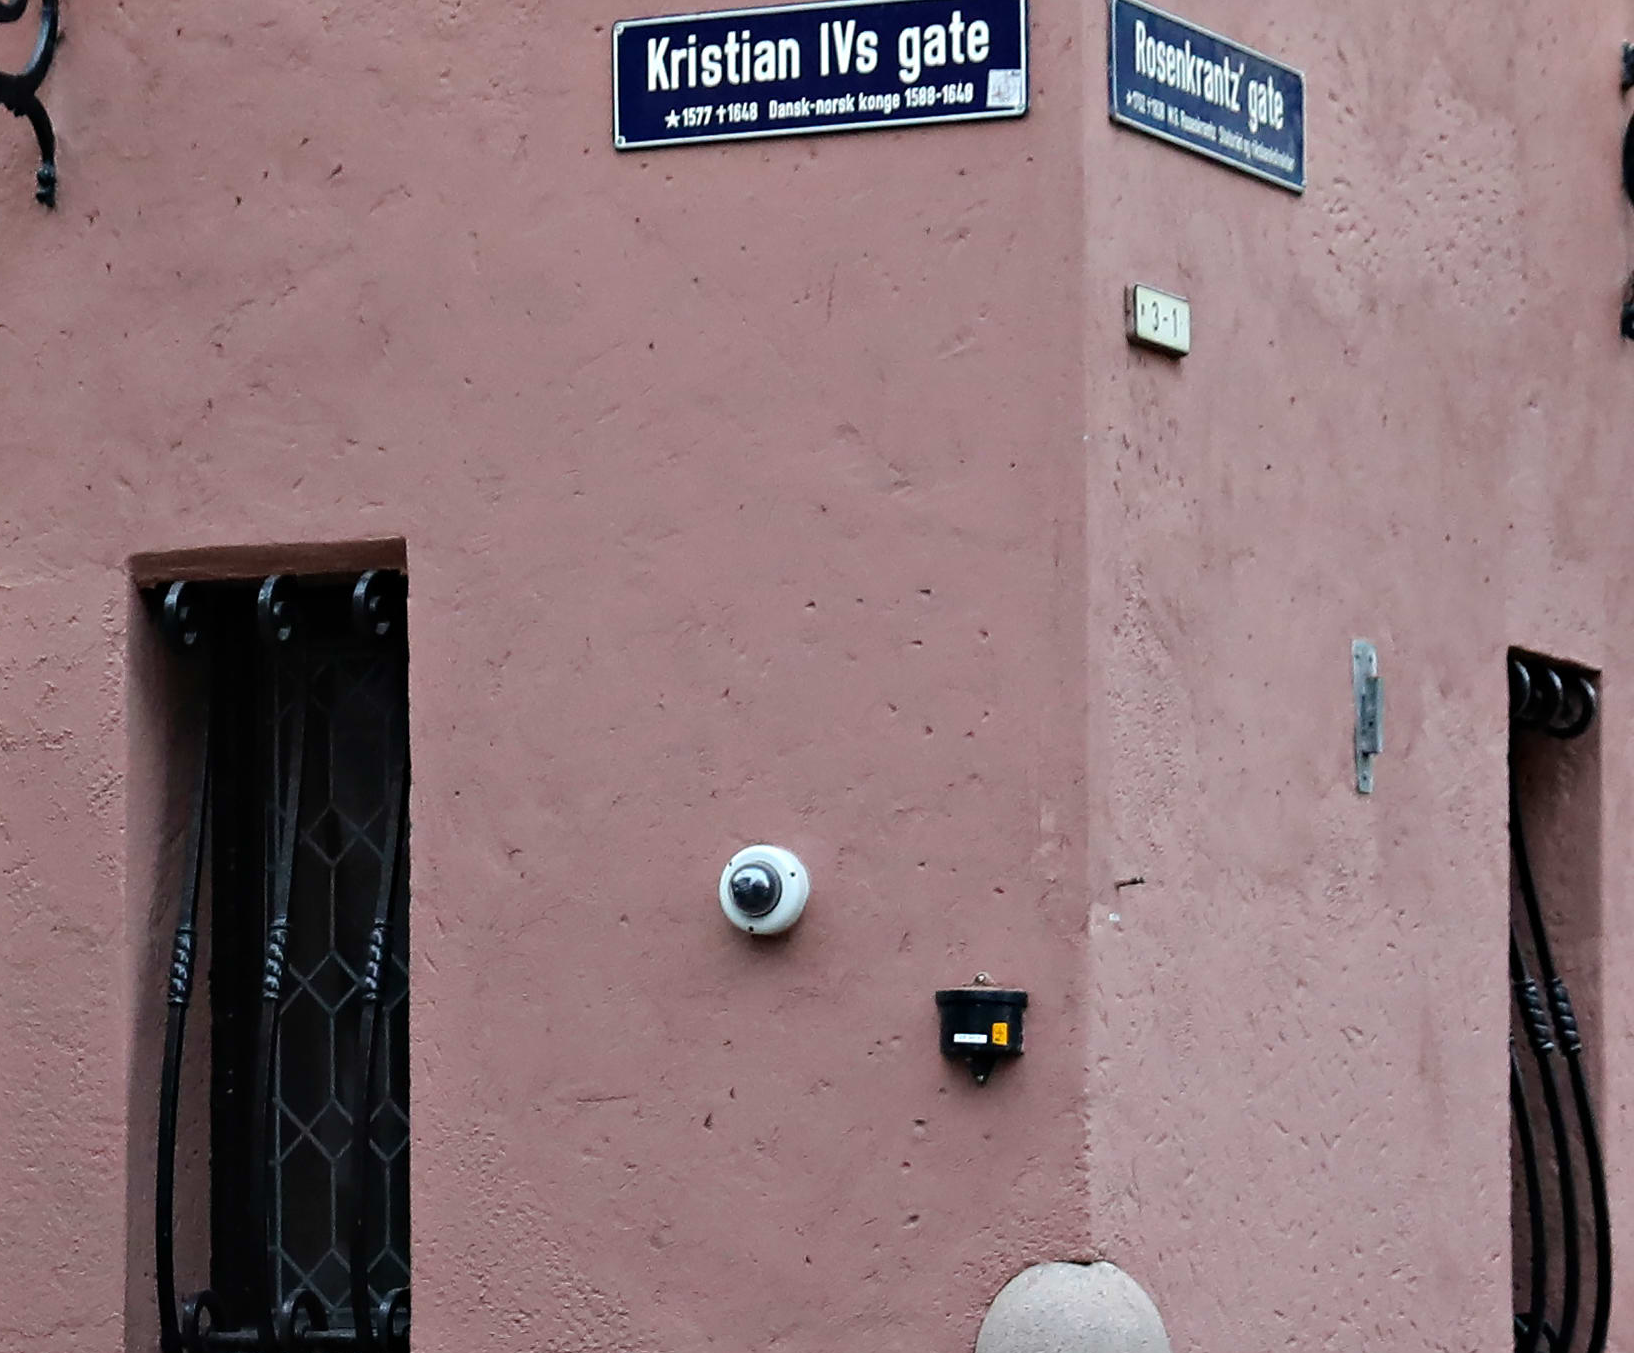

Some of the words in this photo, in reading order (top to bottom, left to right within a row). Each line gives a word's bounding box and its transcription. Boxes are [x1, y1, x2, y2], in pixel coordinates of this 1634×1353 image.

[646, 29, 801, 92] Kristian
[819, 18, 879, 77] IVs
[897, 9, 990, 85] gate
[768, 92, 856, 120] Dansk-norsk
[858, 90, 901, 115] konge
[1246, 75, 1285, 134] gate
